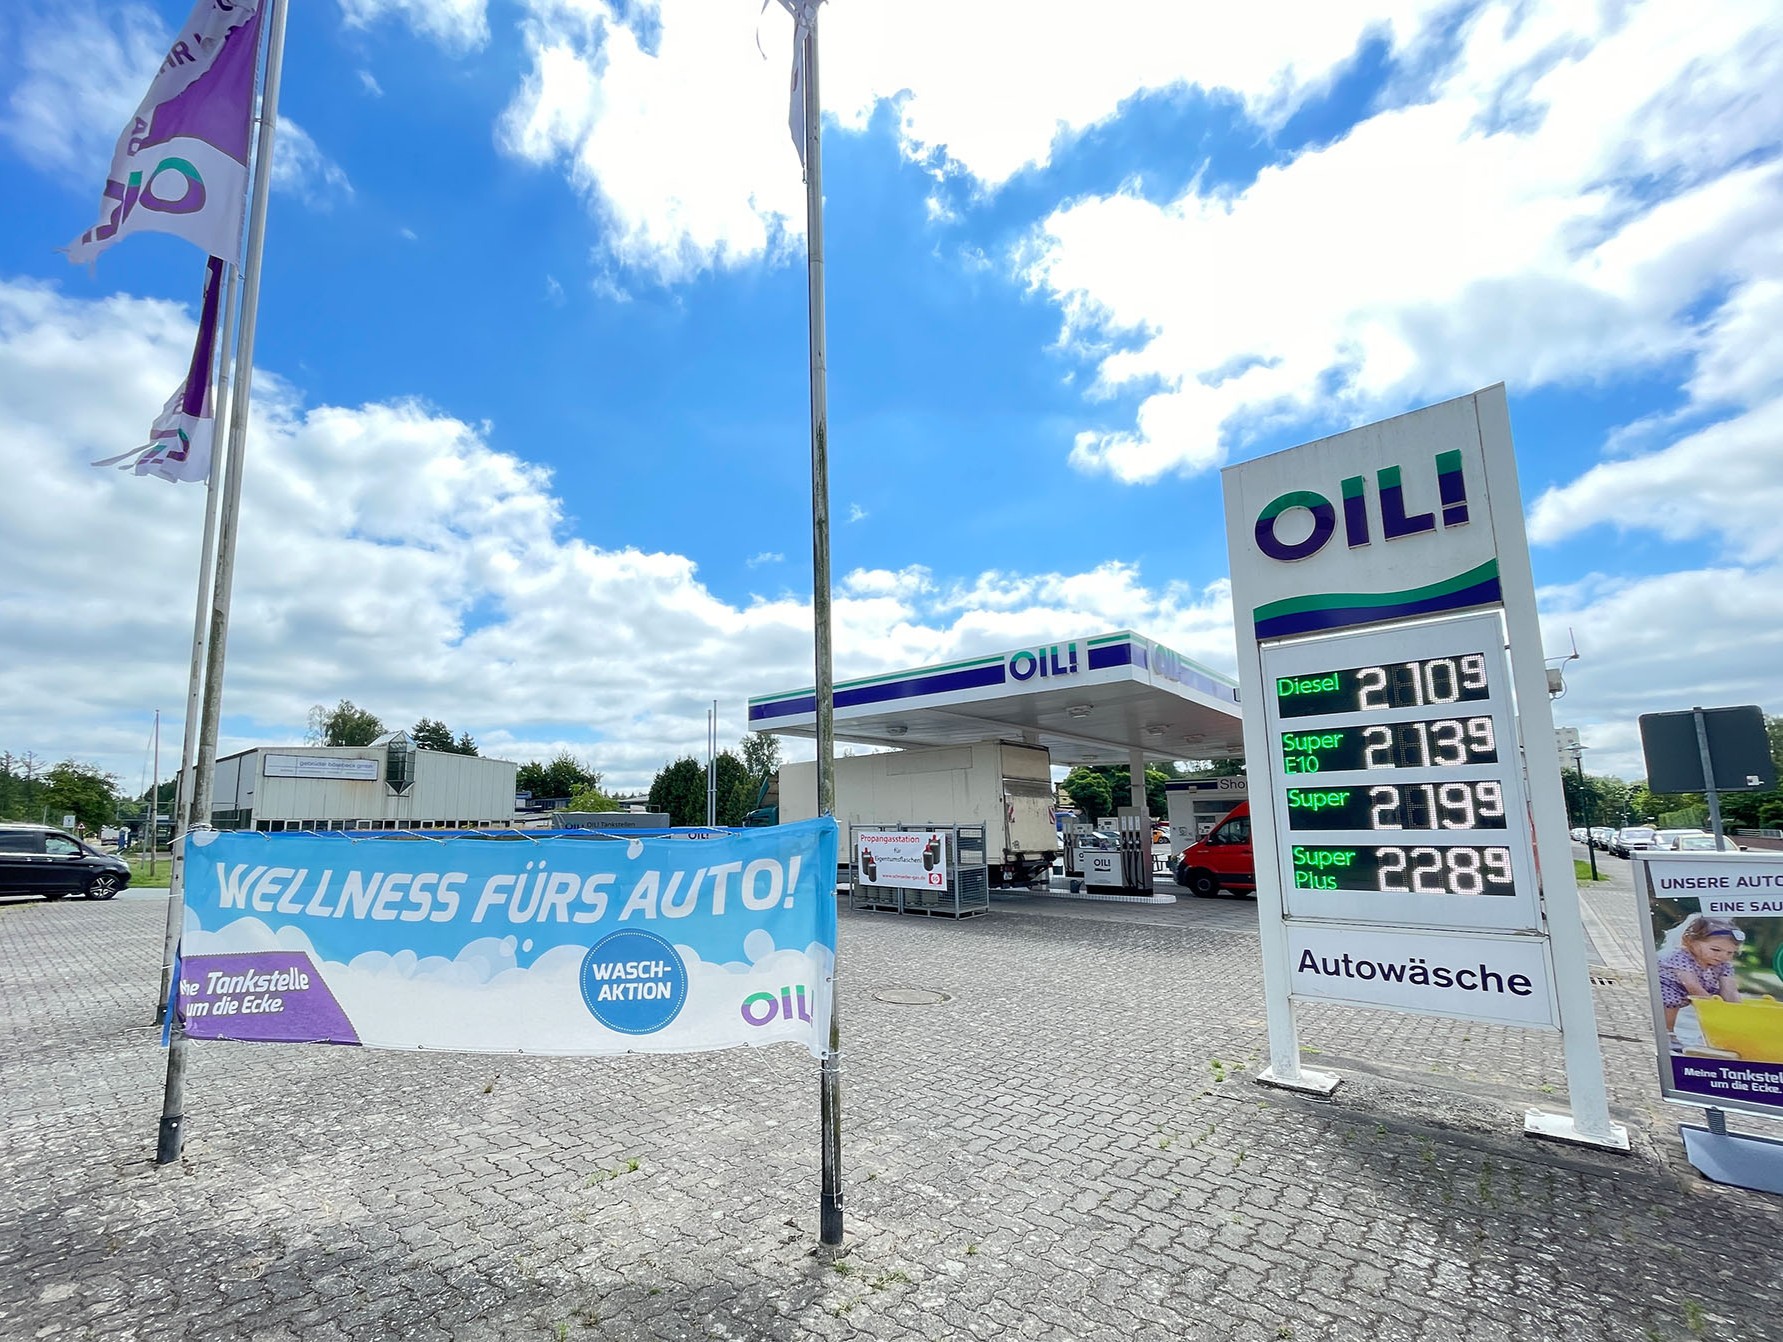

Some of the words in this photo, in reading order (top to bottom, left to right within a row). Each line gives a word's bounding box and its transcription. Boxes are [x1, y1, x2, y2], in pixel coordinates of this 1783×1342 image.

[1254, 449, 1470, 562] OIL!
[1009, 643, 1078, 681] OIL!
[1278, 673, 1339, 697] Diesel
[1282, 733, 1344, 754] Super
[1284, 755, 1319, 774] E10
[1220, 779, 1247, 790] Sho
[1288, 789, 1350, 812] Super
[860, 834, 920, 844] Propangasstation
[1293, 847, 1356, 870] Super
[216, 862, 468, 923] WELLNESS
[471, 860, 616, 924] FÜRS
[618, 855, 802, 922] AUTO!
[1295, 871, 1337, 890] Plus
[1661, 877, 1729, 889] UNSERE
[1710, 902, 1744, 912] EINE
[1750, 902, 1783, 912] SAU
[206, 967, 309, 995] Tankstelle
[592, 960, 672, 982] WASCH-
[1298, 949, 1532, 996] Autowäsche
[597, 981, 672, 1001] AKTION
[186, 1001, 209, 1016] um
[212, 995, 239, 1015] die
[241, 994, 284, 1014] Ecke.
[1684, 1067, 1717, 1079] Meine
[1711, 1081, 1729, 1089] um
[1731, 1080, 1749, 1091] die
[1752, 1082, 1782, 1094] Ecke.
